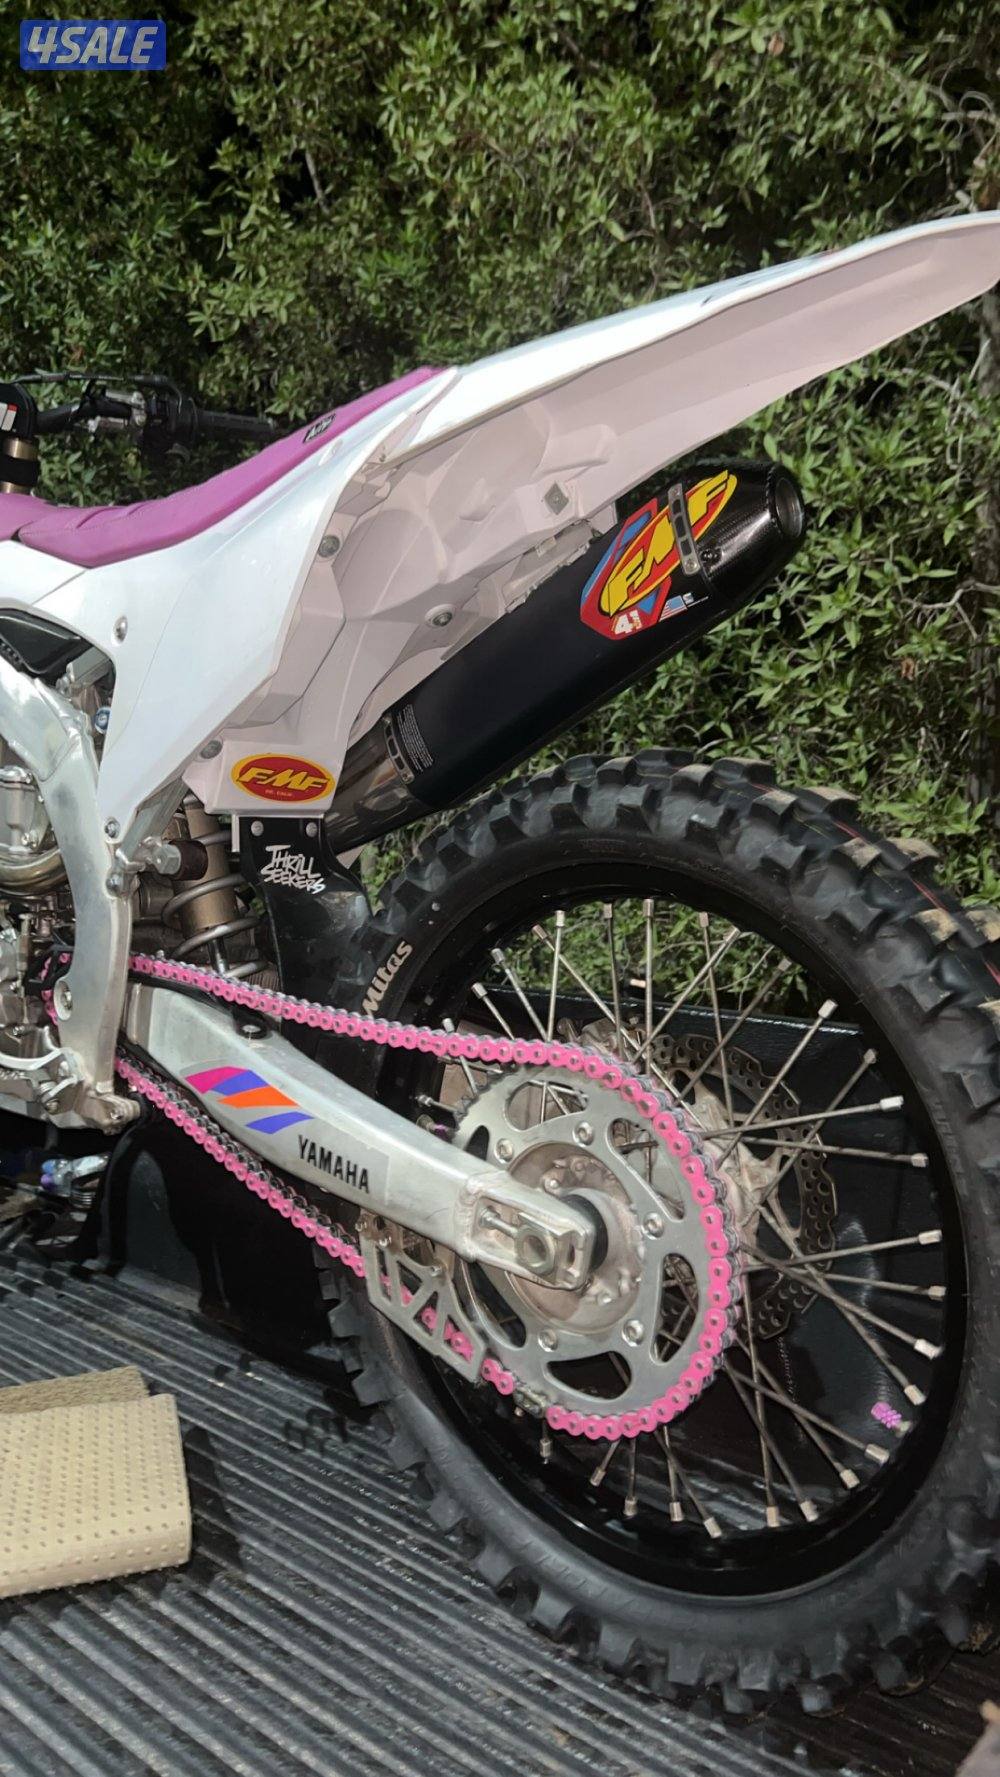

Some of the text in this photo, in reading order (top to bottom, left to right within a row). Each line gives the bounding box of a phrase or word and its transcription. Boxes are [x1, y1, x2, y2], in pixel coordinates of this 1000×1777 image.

[608, 470, 730, 618] FMF
[238, 766, 328, 791] FMF
[298, 1134, 370, 1194] YAMAHA
